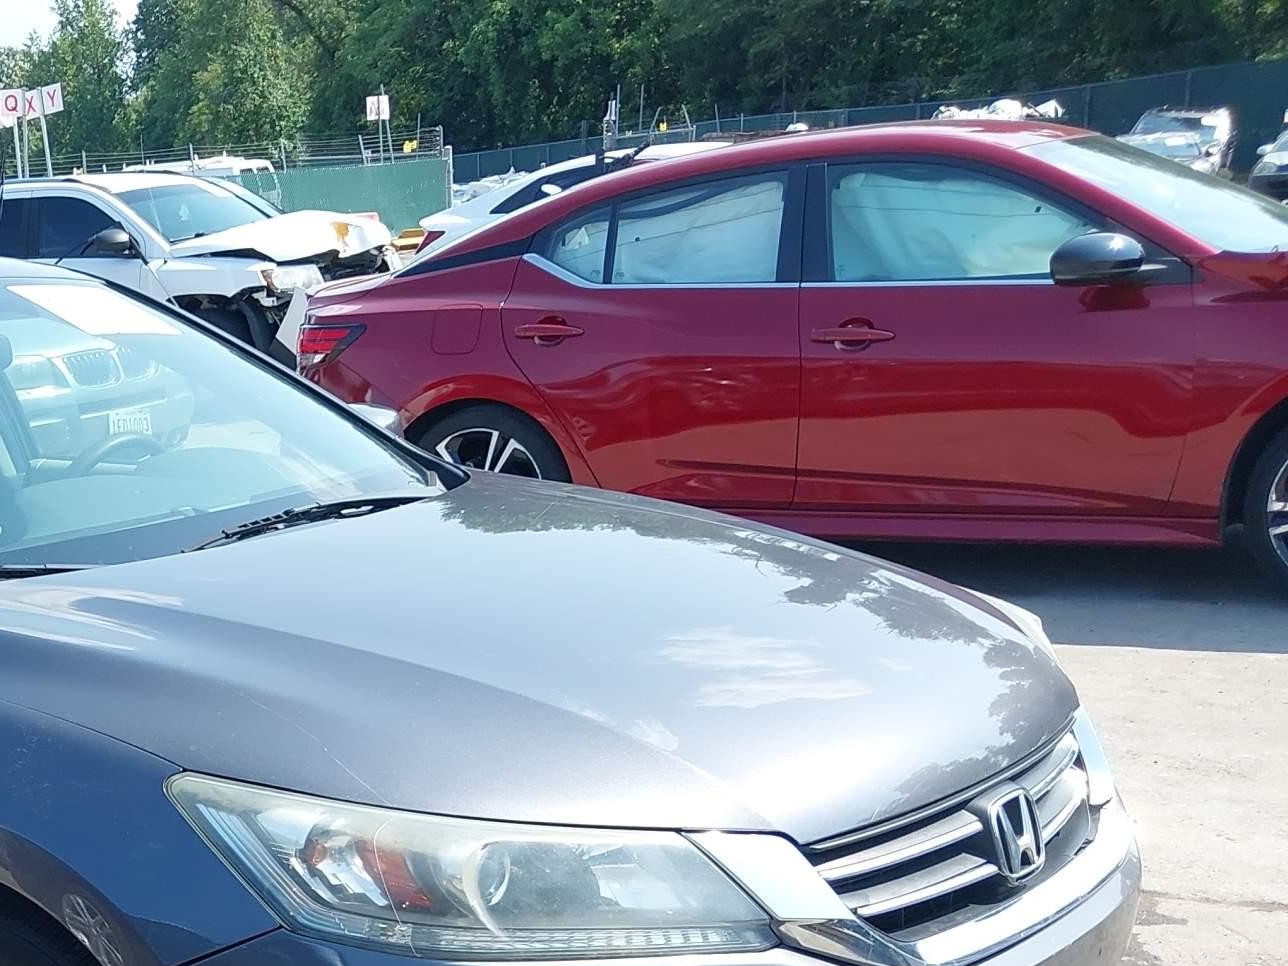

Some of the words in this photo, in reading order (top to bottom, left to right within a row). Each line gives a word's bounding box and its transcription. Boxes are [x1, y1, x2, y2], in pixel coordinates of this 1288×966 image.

[4, 94, 18, 112] Q
[26, 95, 36, 113] X
[46, 89, 57, 107] Y
